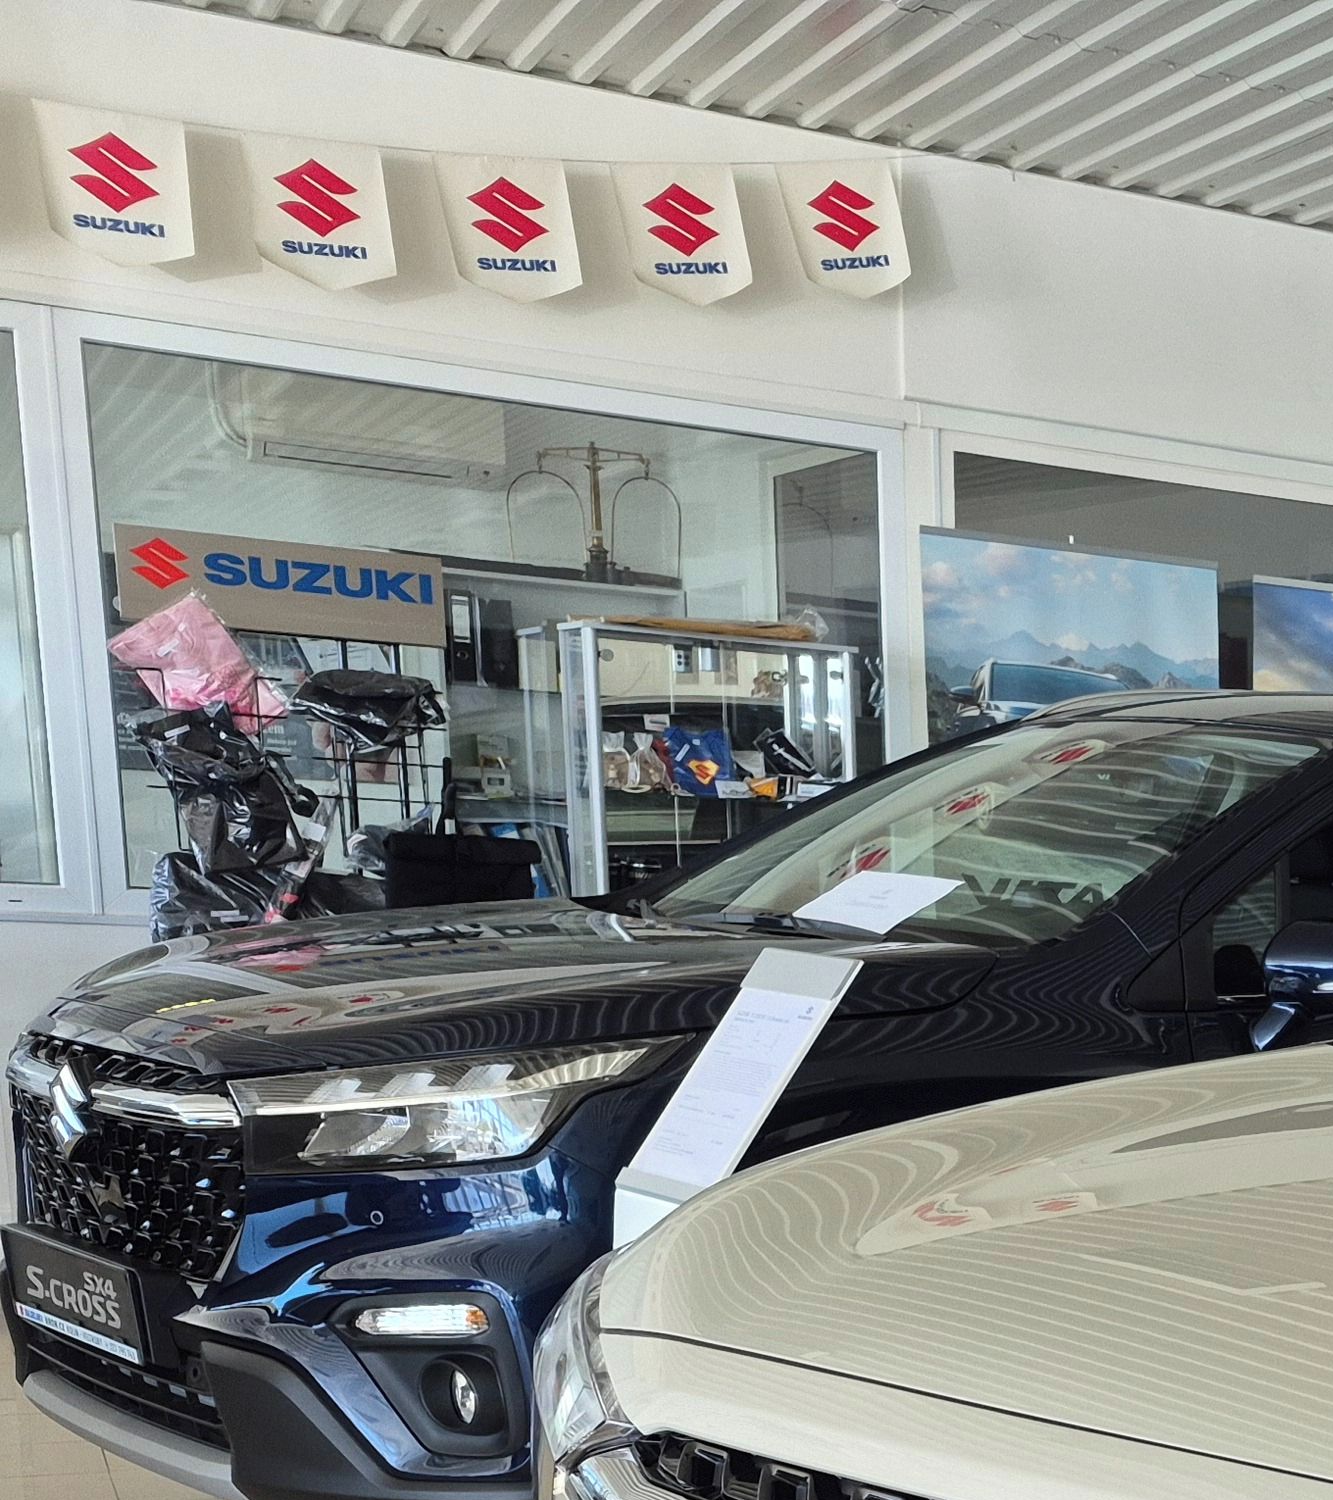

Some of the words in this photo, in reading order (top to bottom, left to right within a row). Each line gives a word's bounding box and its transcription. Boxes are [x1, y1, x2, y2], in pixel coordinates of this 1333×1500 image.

[73, 213, 166, 239] SUZUKI
[282, 239, 368, 260] SUZUKI
[477, 257, 557, 274] SUZUKI
[655, 261, 729, 276] SUZUKI
[821, 254, 890, 272] SUZUKI
[203, 552, 433, 605] SUZUKI
[83, 1271, 117, 1299] SX4
